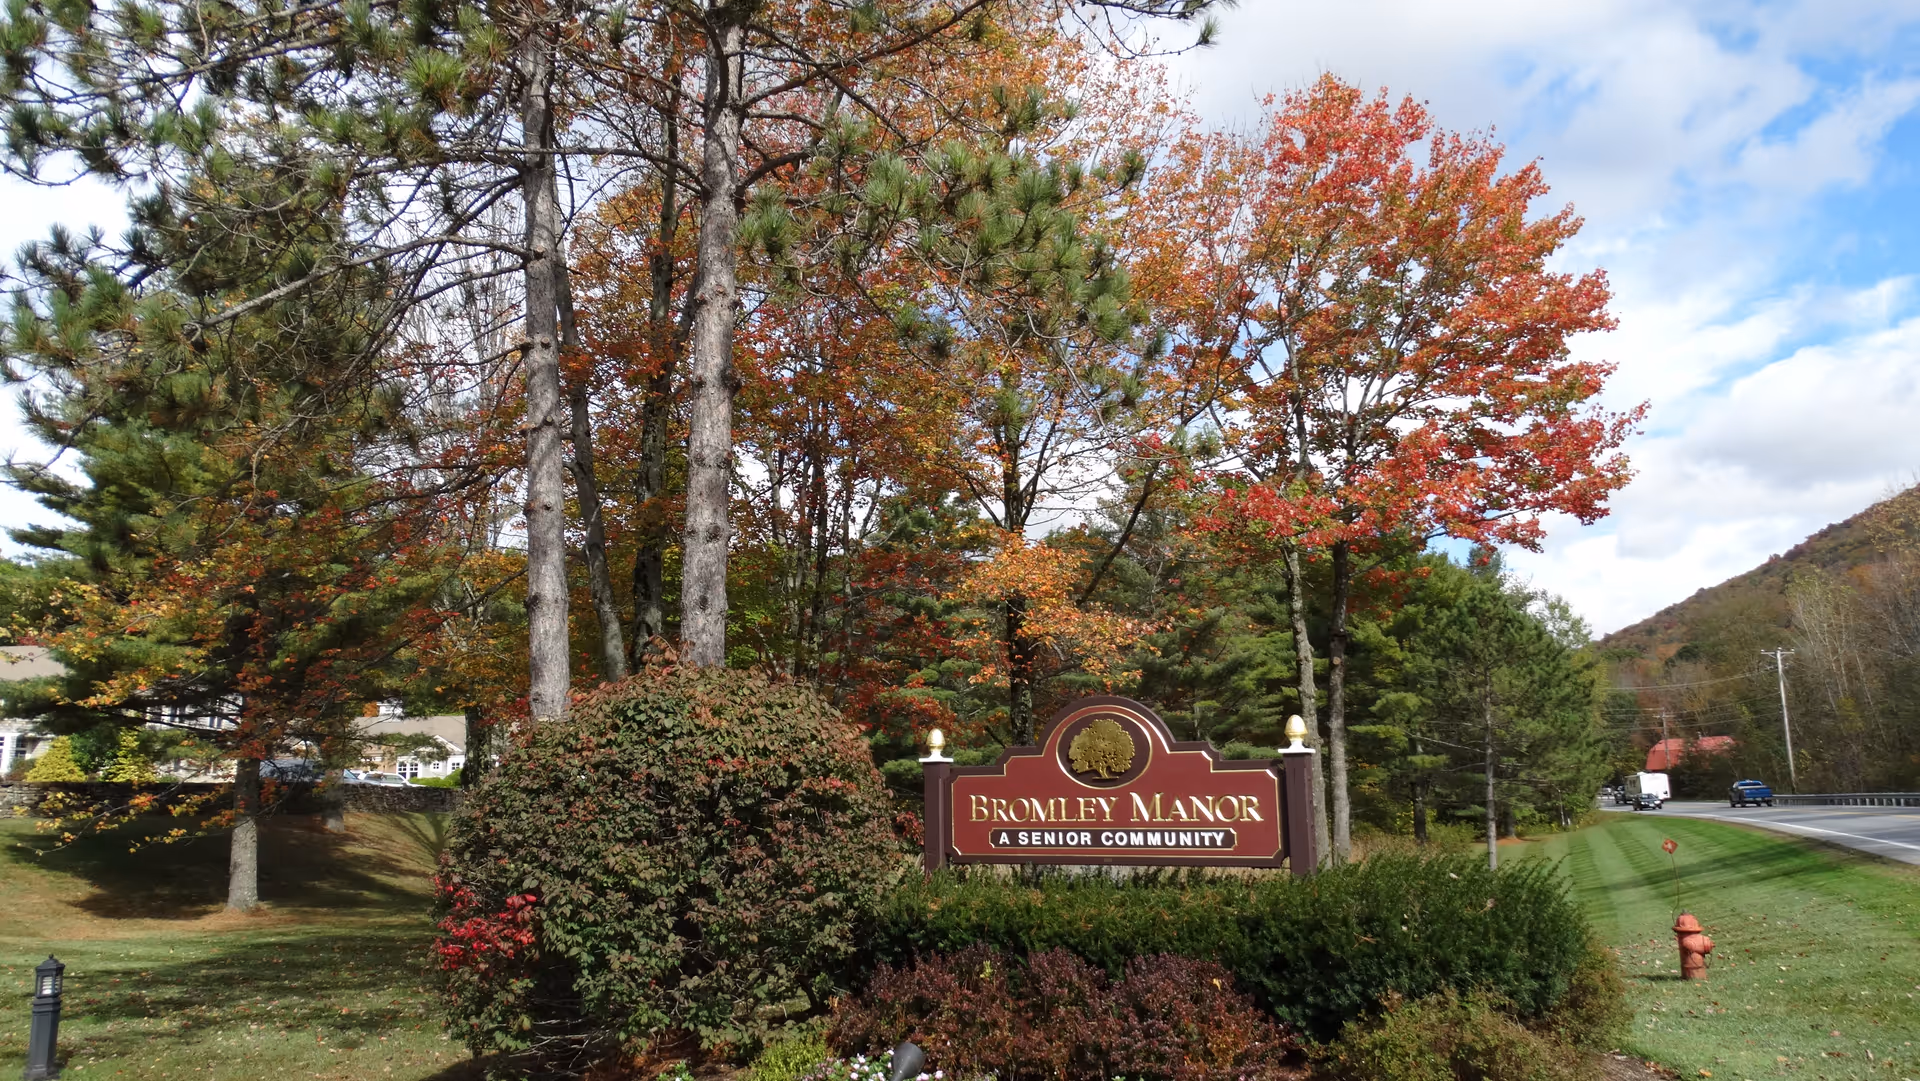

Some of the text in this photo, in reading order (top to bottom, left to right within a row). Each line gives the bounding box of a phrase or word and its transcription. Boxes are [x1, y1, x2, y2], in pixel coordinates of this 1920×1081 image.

[969, 792, 1264, 822] BROMLEY MANOR
[999, 831, 1225, 846] A SENIOR COMMUNITY
